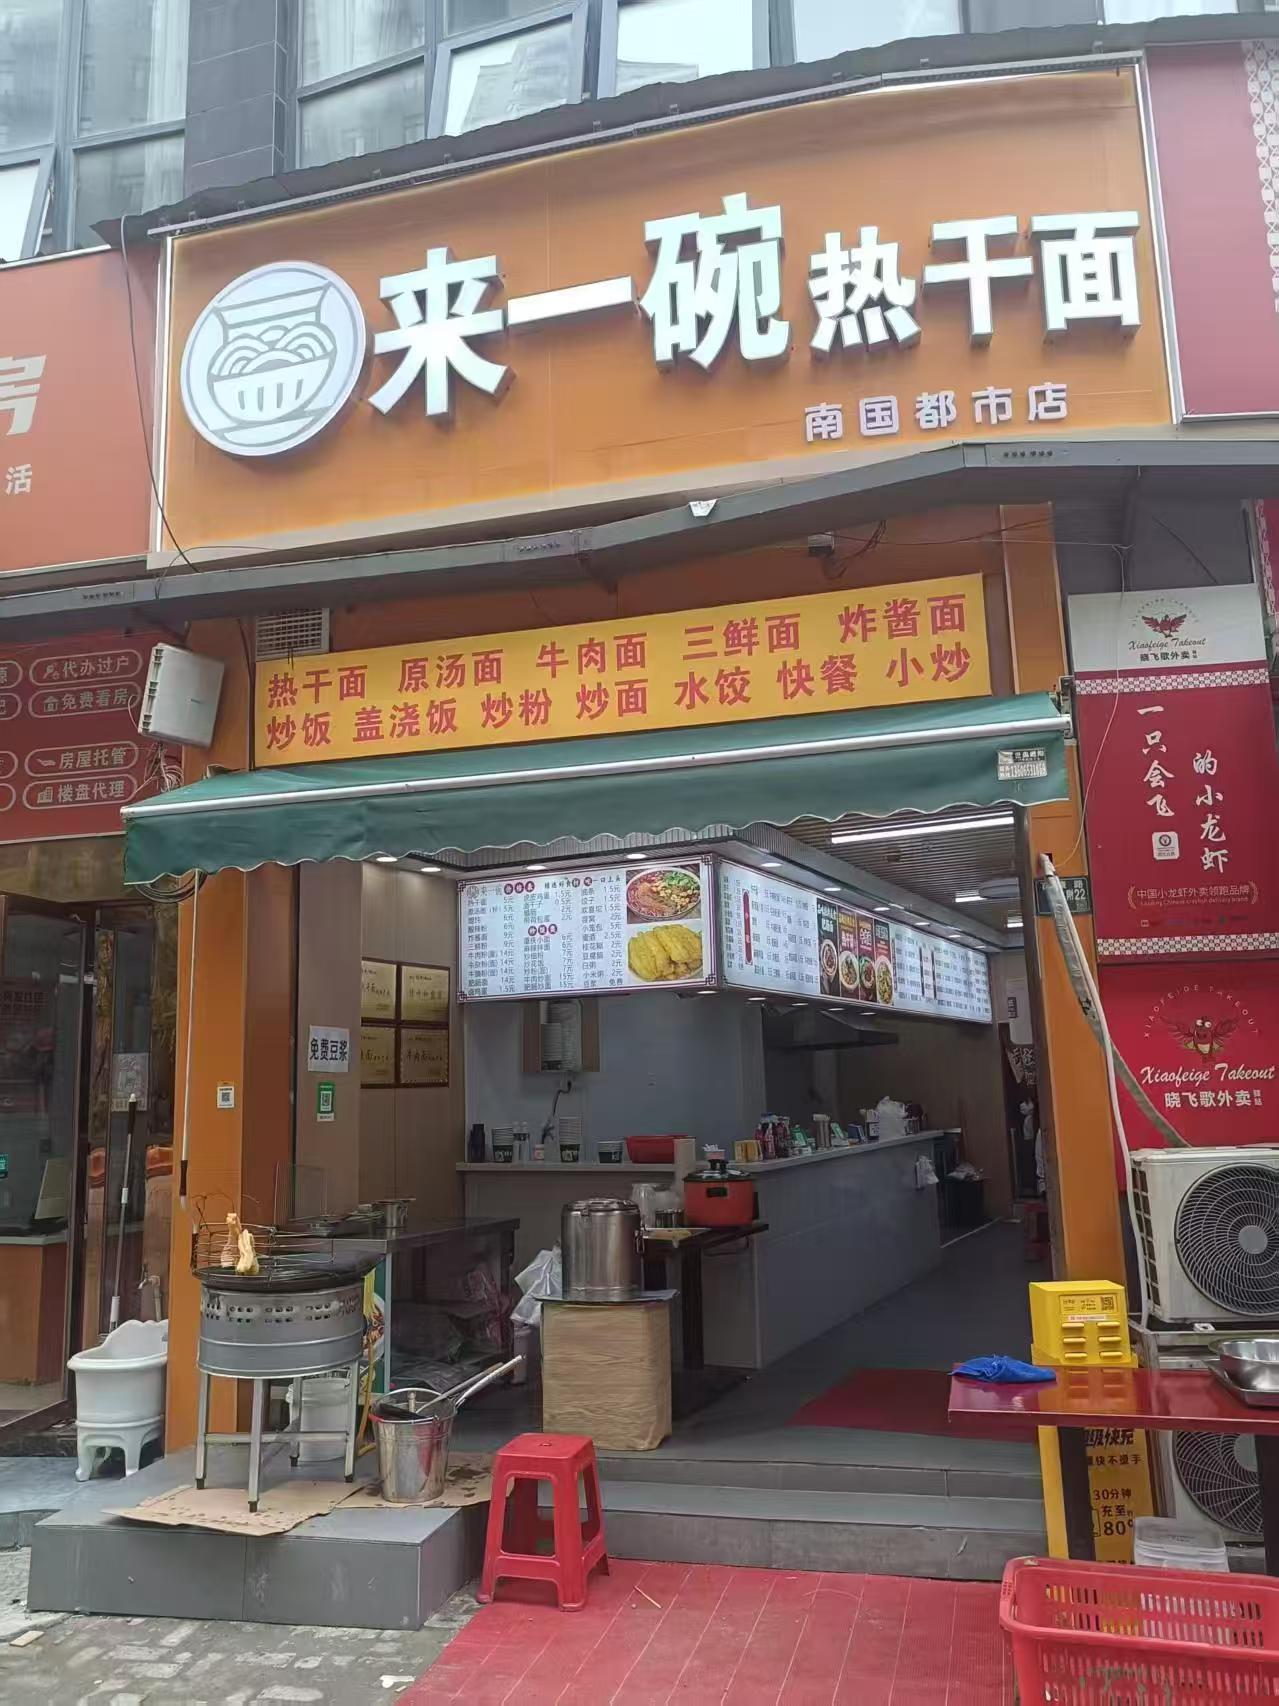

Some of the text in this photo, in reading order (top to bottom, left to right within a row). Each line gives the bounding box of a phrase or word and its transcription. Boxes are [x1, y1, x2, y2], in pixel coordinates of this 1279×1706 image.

[369, 192, 1142, 418] 来一碗热干面
[804, 382, 1068, 442] 南国都市店
[268, 594, 966, 709] 热干面 原汤面 牛肉面 三鲜面 炸酱面
[62, 656, 129, 678] 代办过户
[62, 688, 129, 710] 免费看房
[266, 641, 970, 750] 炒饭 盖浇饭 炒粉 炒面 水饺 快餐 小炒
[60, 747, 126, 769] 房屋托管
[1137, 705, 1175, 817] 一只会飞
[57, 780, 125, 803] 楼盘代理
[1192, 750, 1230, 873] 的小龙虾
[310, 1038, 348, 1062] 免费豆浆
[1140, 1063, 1276, 1087] Xiaofeige Takeout
[1165, 1089, 1251, 1108] 晓飞歌外卖
